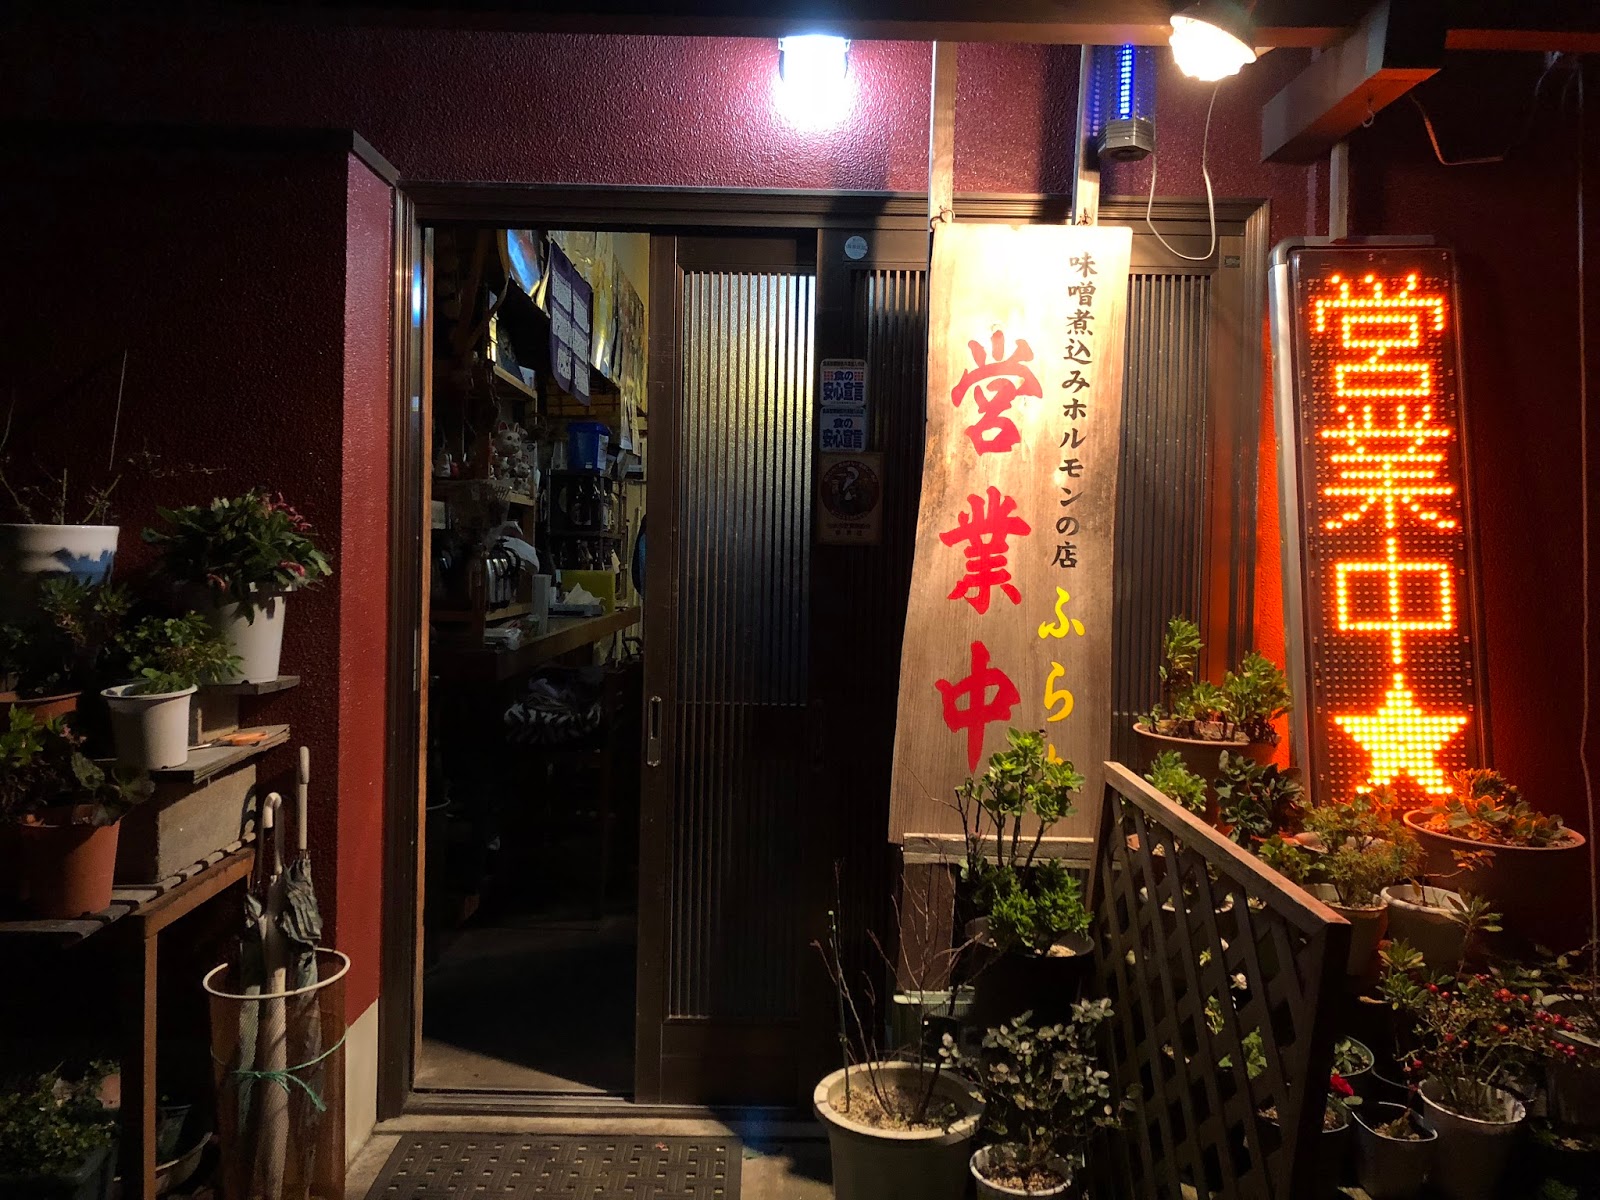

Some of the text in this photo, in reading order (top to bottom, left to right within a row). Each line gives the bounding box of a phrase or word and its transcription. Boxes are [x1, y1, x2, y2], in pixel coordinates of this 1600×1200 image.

[934, 329, 1043, 774] 営業中
[1051, 251, 1098, 569] 味噌煮込みホルモンの店
[1315, 273, 1457, 665] 営業中
